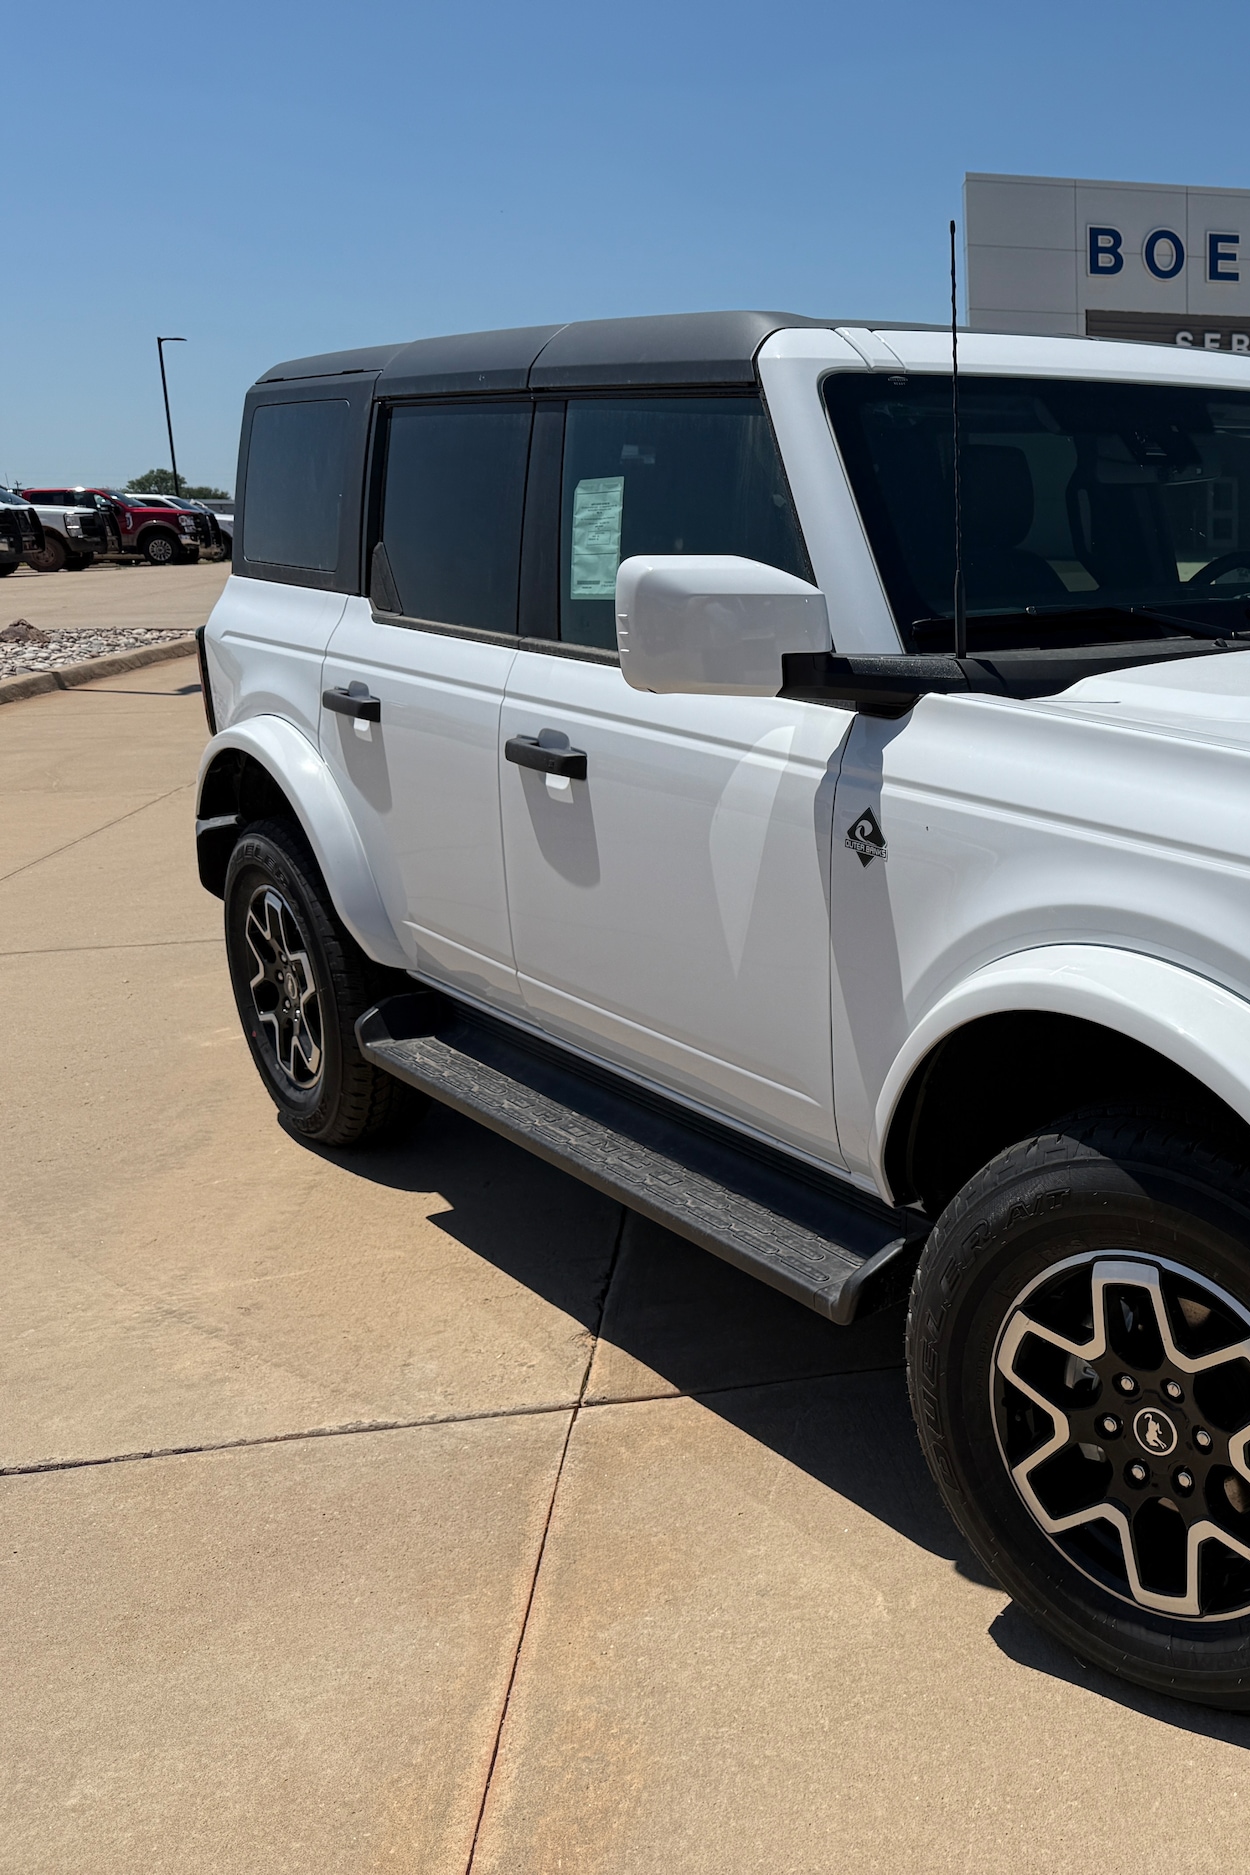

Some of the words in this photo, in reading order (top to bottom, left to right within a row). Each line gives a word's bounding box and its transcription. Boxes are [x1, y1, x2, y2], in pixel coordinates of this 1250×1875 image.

[845, 840, 865, 852] OUTER
[866, 845, 886, 858] BANKS
[921, 1218, 992, 1491] DUELER
[1004, 1186, 1072, 1229] A/T
